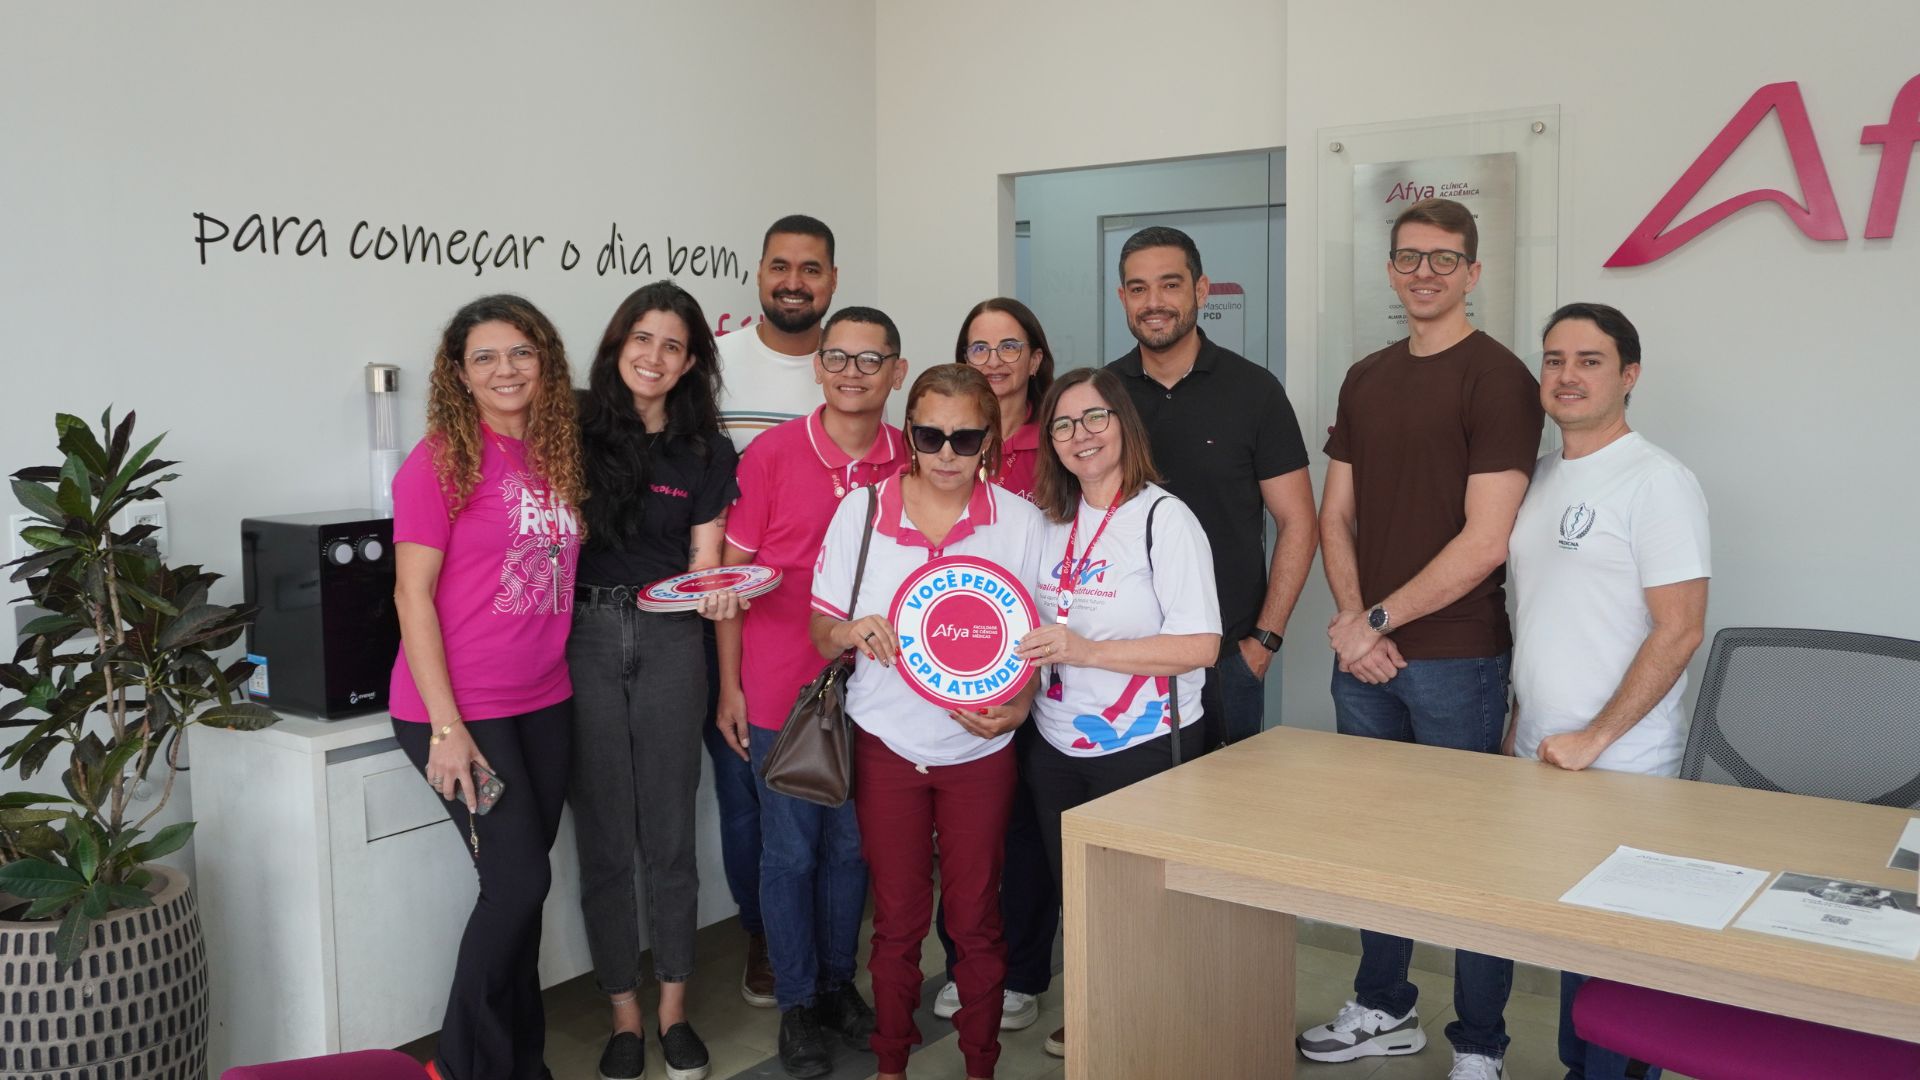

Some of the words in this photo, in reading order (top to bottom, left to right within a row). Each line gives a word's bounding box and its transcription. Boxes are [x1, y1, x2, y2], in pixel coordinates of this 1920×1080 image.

[1385, 181, 1435, 205] Afya
[1440, 189, 1480, 197] ACADÊMICA
[1441, 182, 1468, 190] CLÍNICA
[193, 212, 328, 265] para
[349, 221, 545, 277] começar
[561, 240, 581, 271] o
[597, 222, 652, 277] dia
[667, 236, 749, 285] bem,
[1204, 302, 1242, 310] Masculino
[1203, 312, 1222, 320] PCD
[536, 537, 568, 548] 205
[907, 570, 957, 610] VOCÊ
[961, 573, 1017, 614] PEDIU,
[931, 624, 969, 641] Afya
[900, 635, 915, 649] A
[909, 652, 942, 689] CPA
